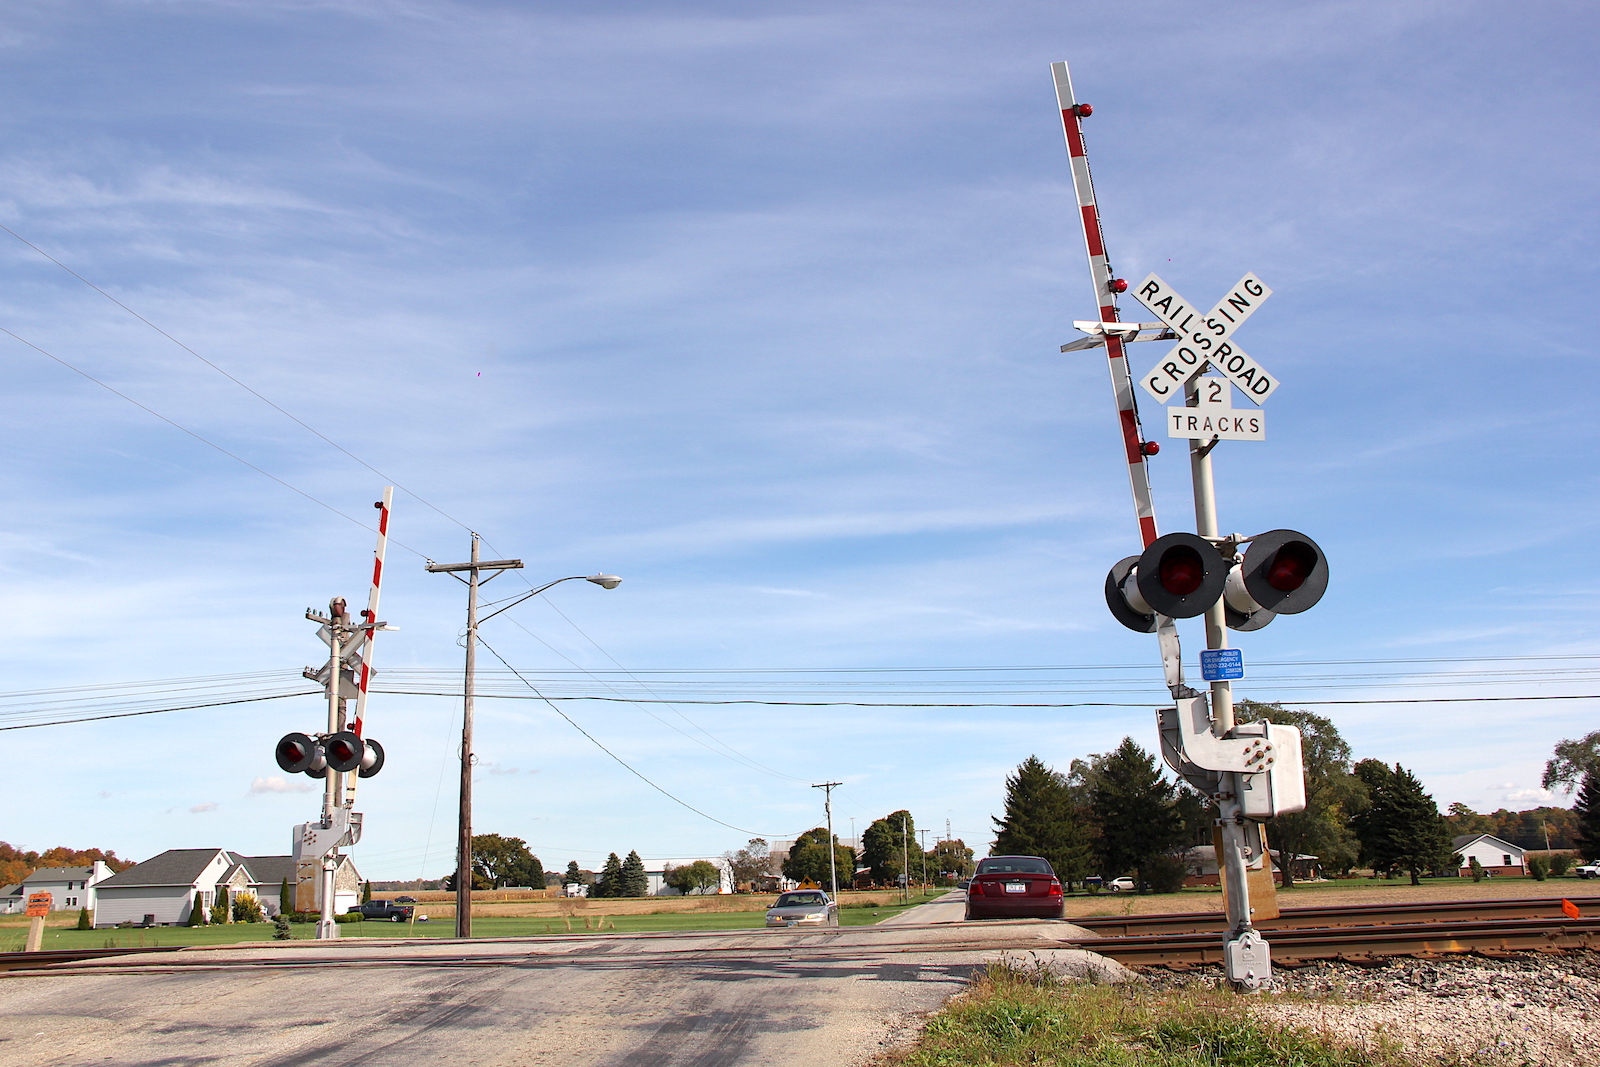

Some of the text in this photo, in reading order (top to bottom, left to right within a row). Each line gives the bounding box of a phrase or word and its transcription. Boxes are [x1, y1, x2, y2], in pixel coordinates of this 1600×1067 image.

[1150, 279, 1263, 395] CROSSING
[1208, 383, 1222, 403] 2
[1172, 415, 1259, 433] TRACKS
